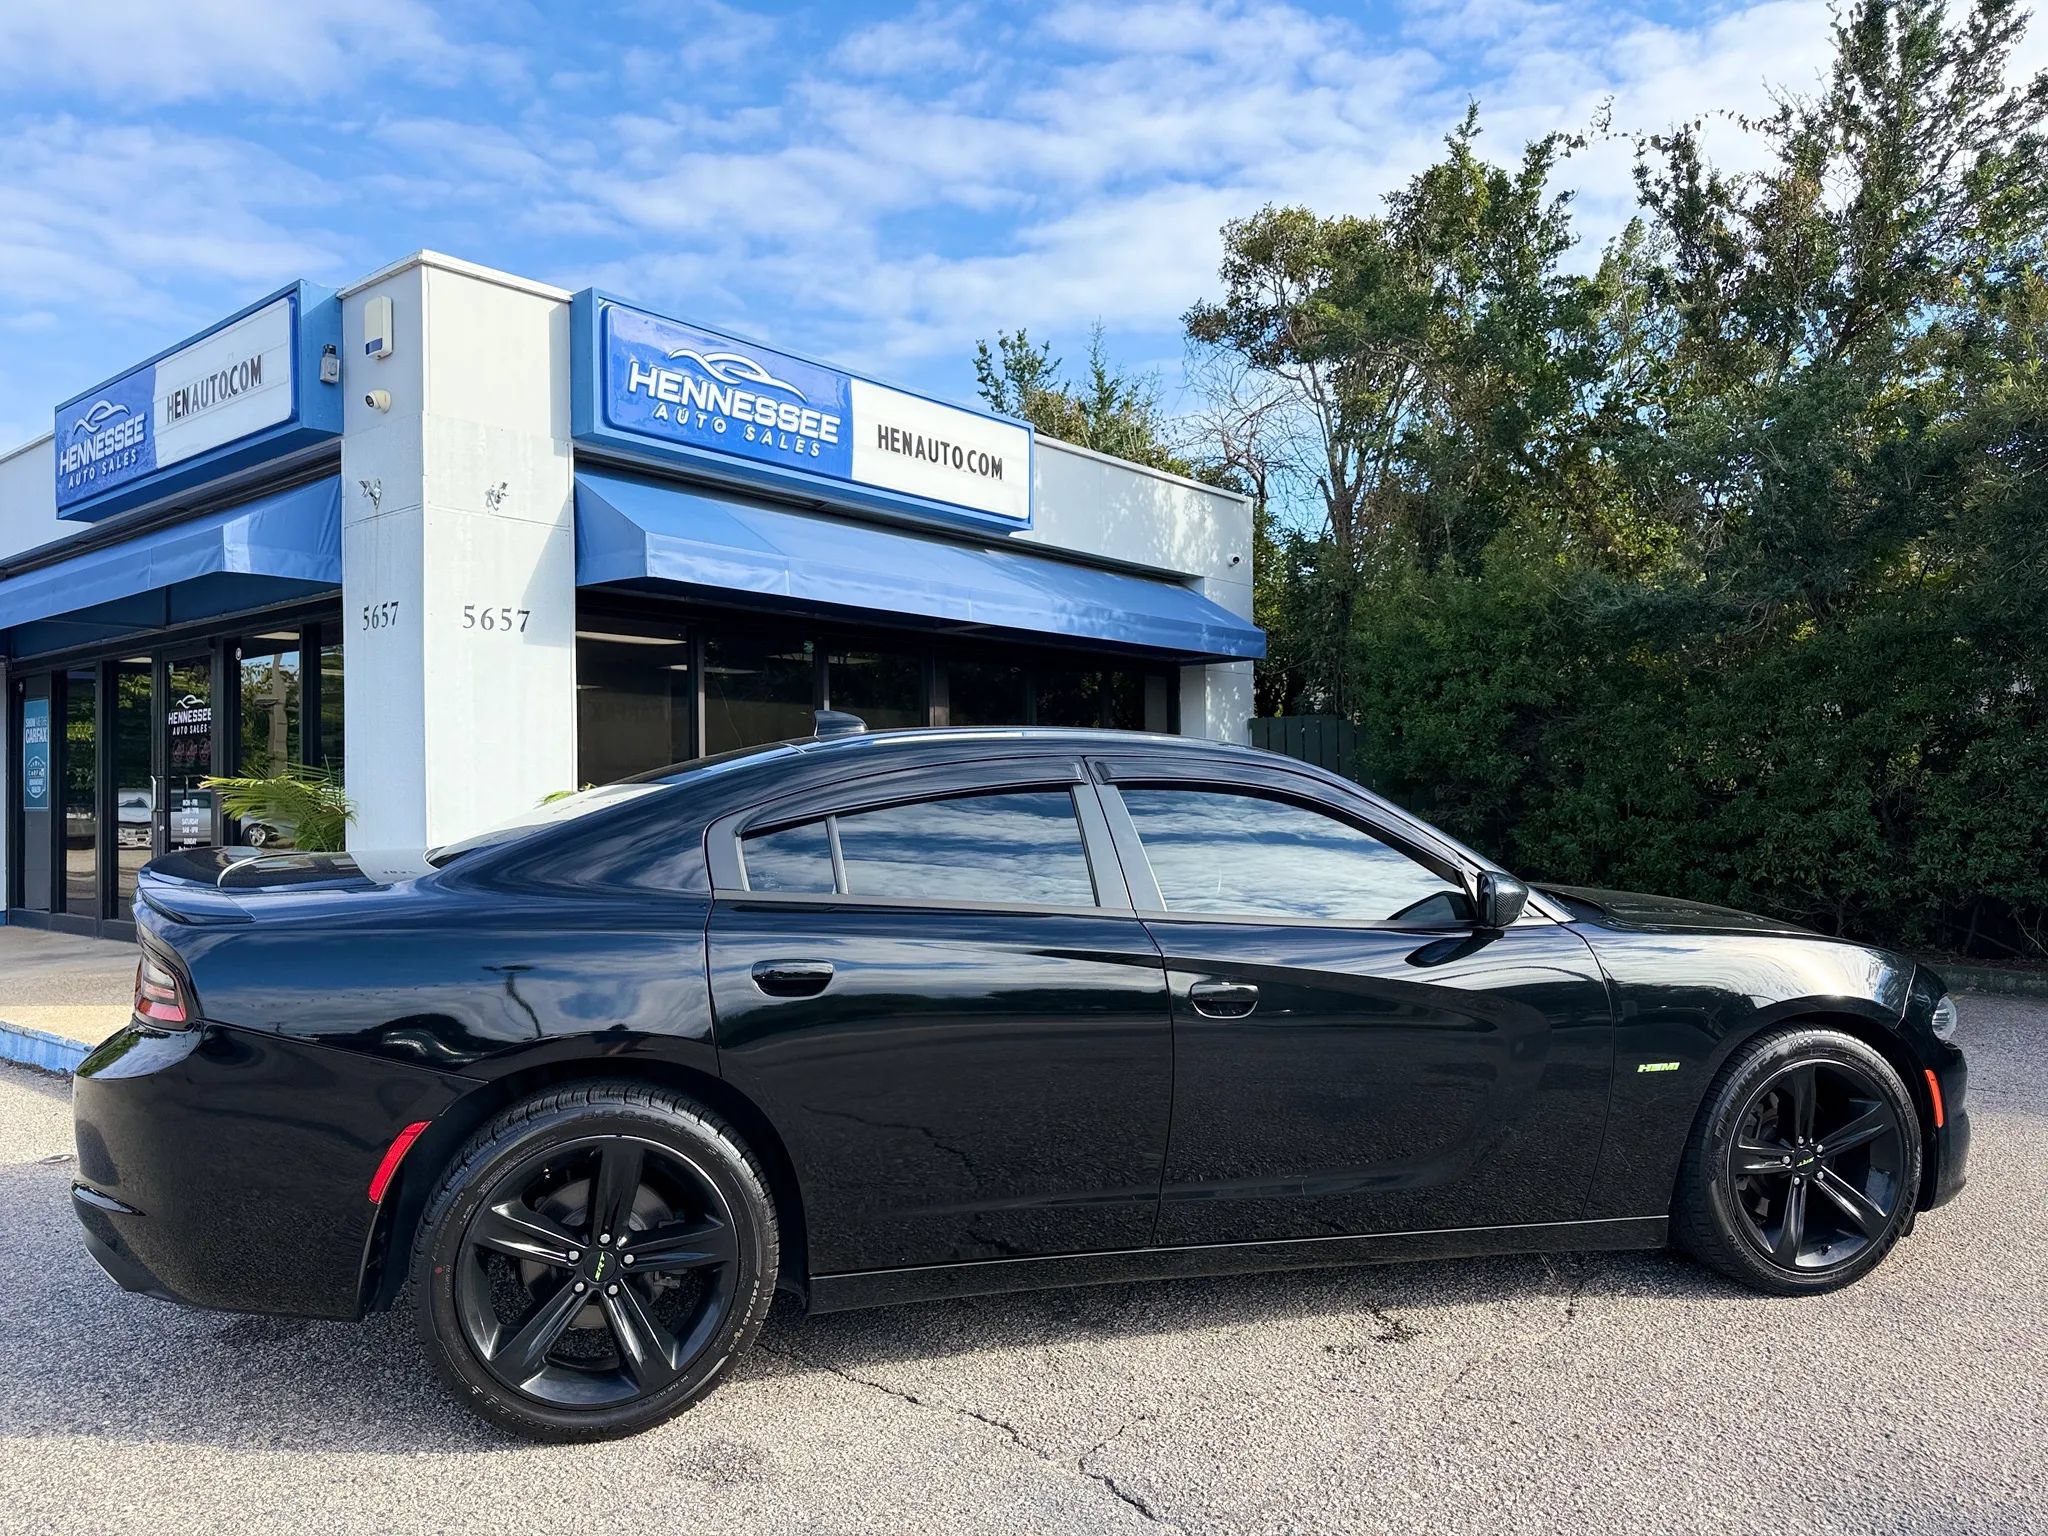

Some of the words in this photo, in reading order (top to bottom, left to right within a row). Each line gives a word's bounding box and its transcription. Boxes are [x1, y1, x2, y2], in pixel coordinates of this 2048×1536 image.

[166, 355, 263, 423] HENAUTO.COM
[628, 361, 841, 444] HENNESSEE
[59, 413, 145, 477] HENNESSEE
[653, 403, 727, 434] AUTO
[744, 425, 821, 457] SALES
[68, 466, 96, 489] AUTO
[101, 450, 138, 476] SALES
[362, 601, 399, 631] 5657
[462, 604, 531, 633] 5657
[168, 708, 212, 725] HENNESSEE
[172, 725, 188, 736] AUTO
[189, 723, 208, 735] SALES
[25, 727, 48, 744] CARFAX
